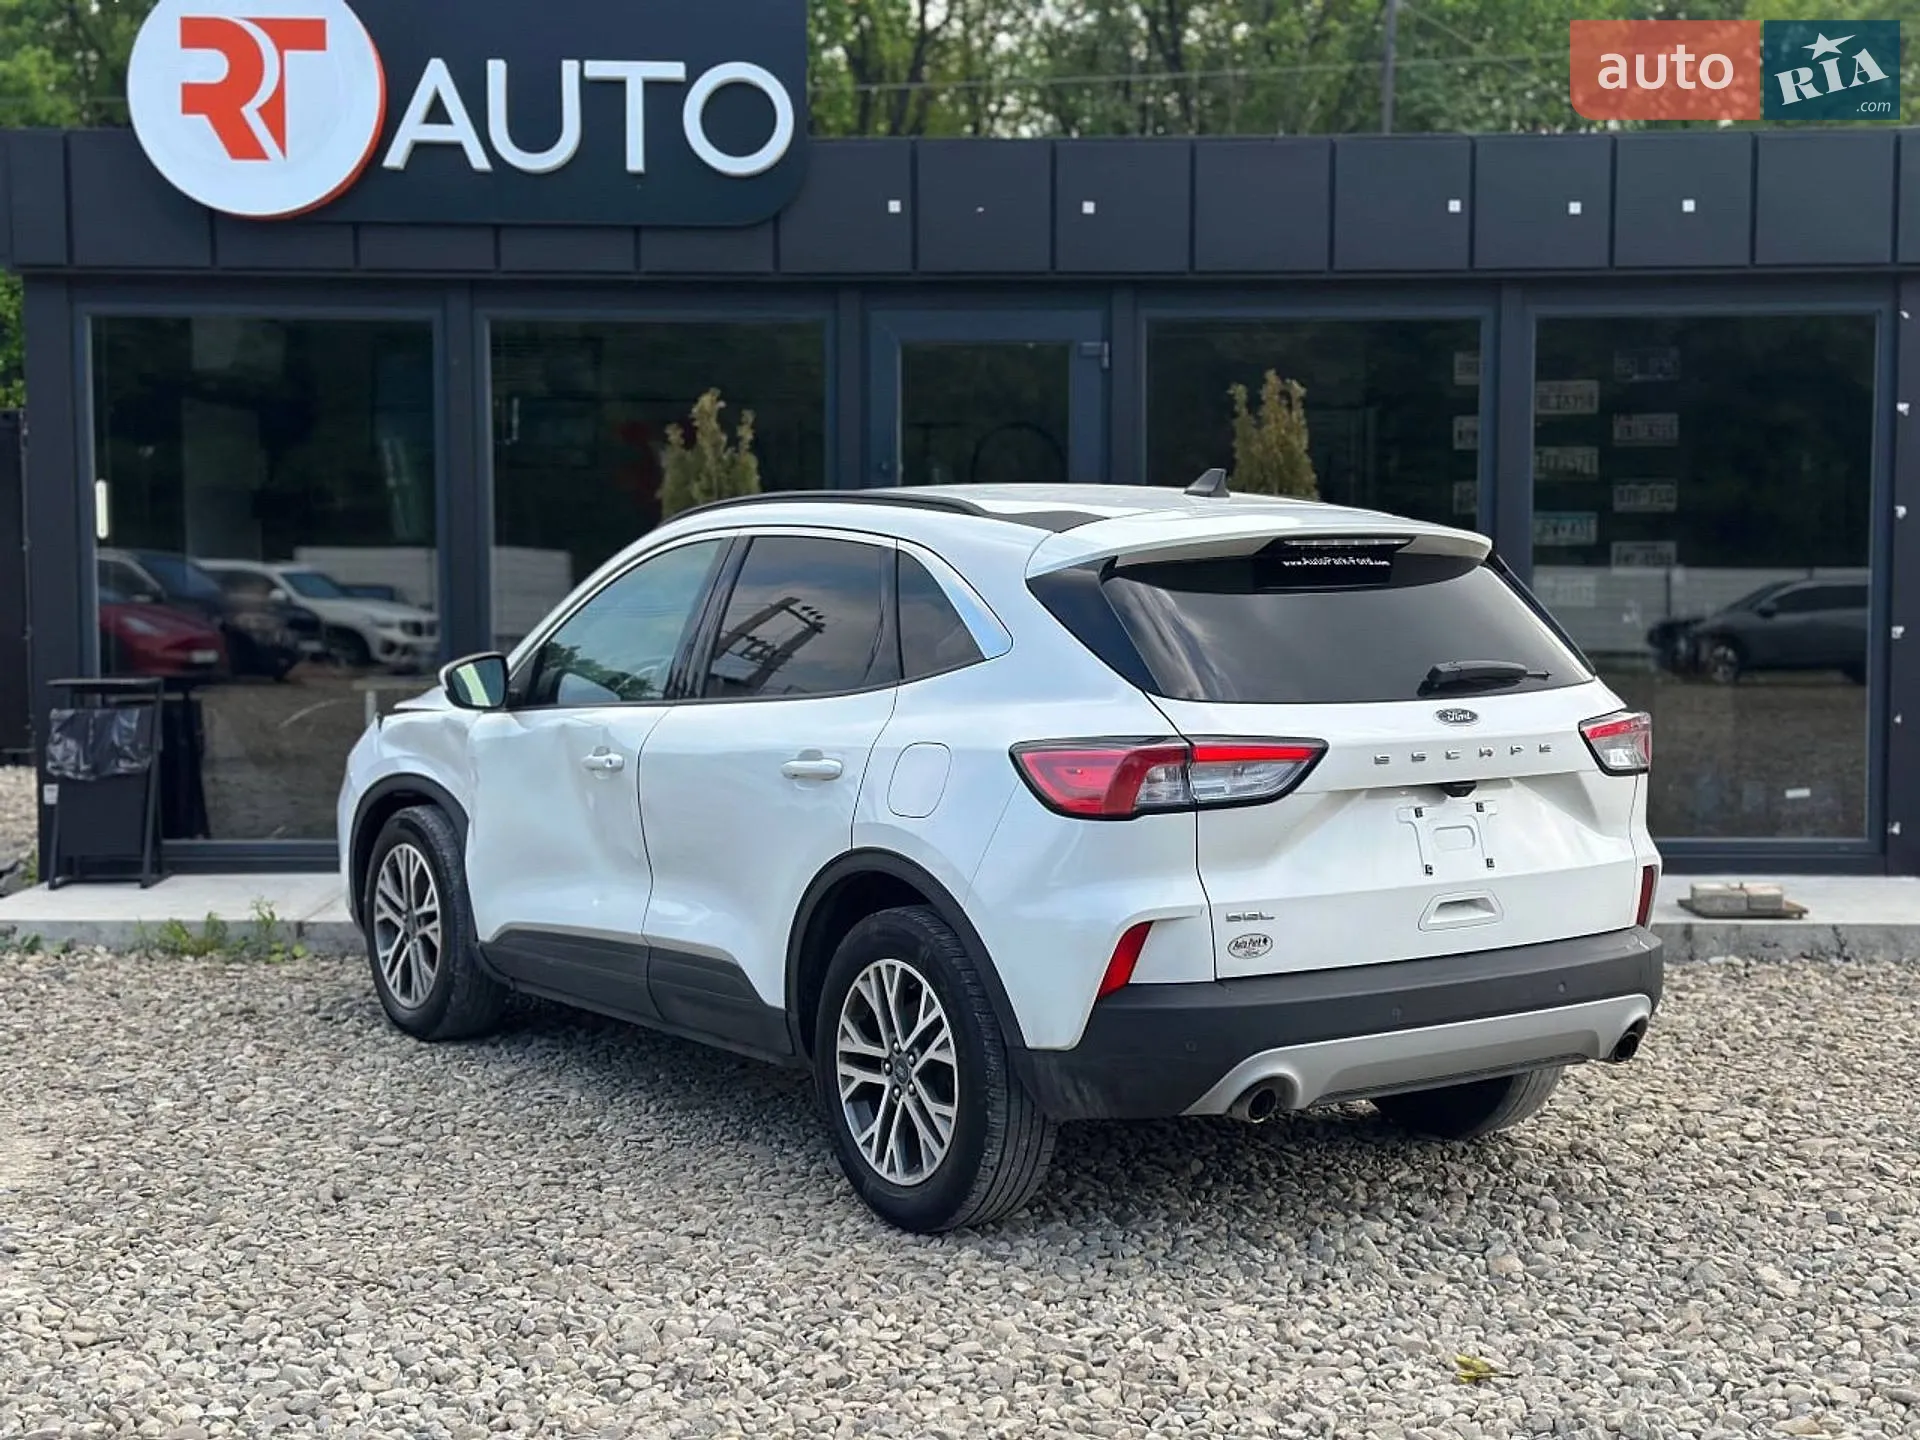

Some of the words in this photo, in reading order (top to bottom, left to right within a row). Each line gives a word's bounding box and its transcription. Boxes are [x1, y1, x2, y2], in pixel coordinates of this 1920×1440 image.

[180, 16, 327, 161] RT
[382, 58, 795, 176] AUTO
[1373, 743, 1553, 765] ESCAPE
